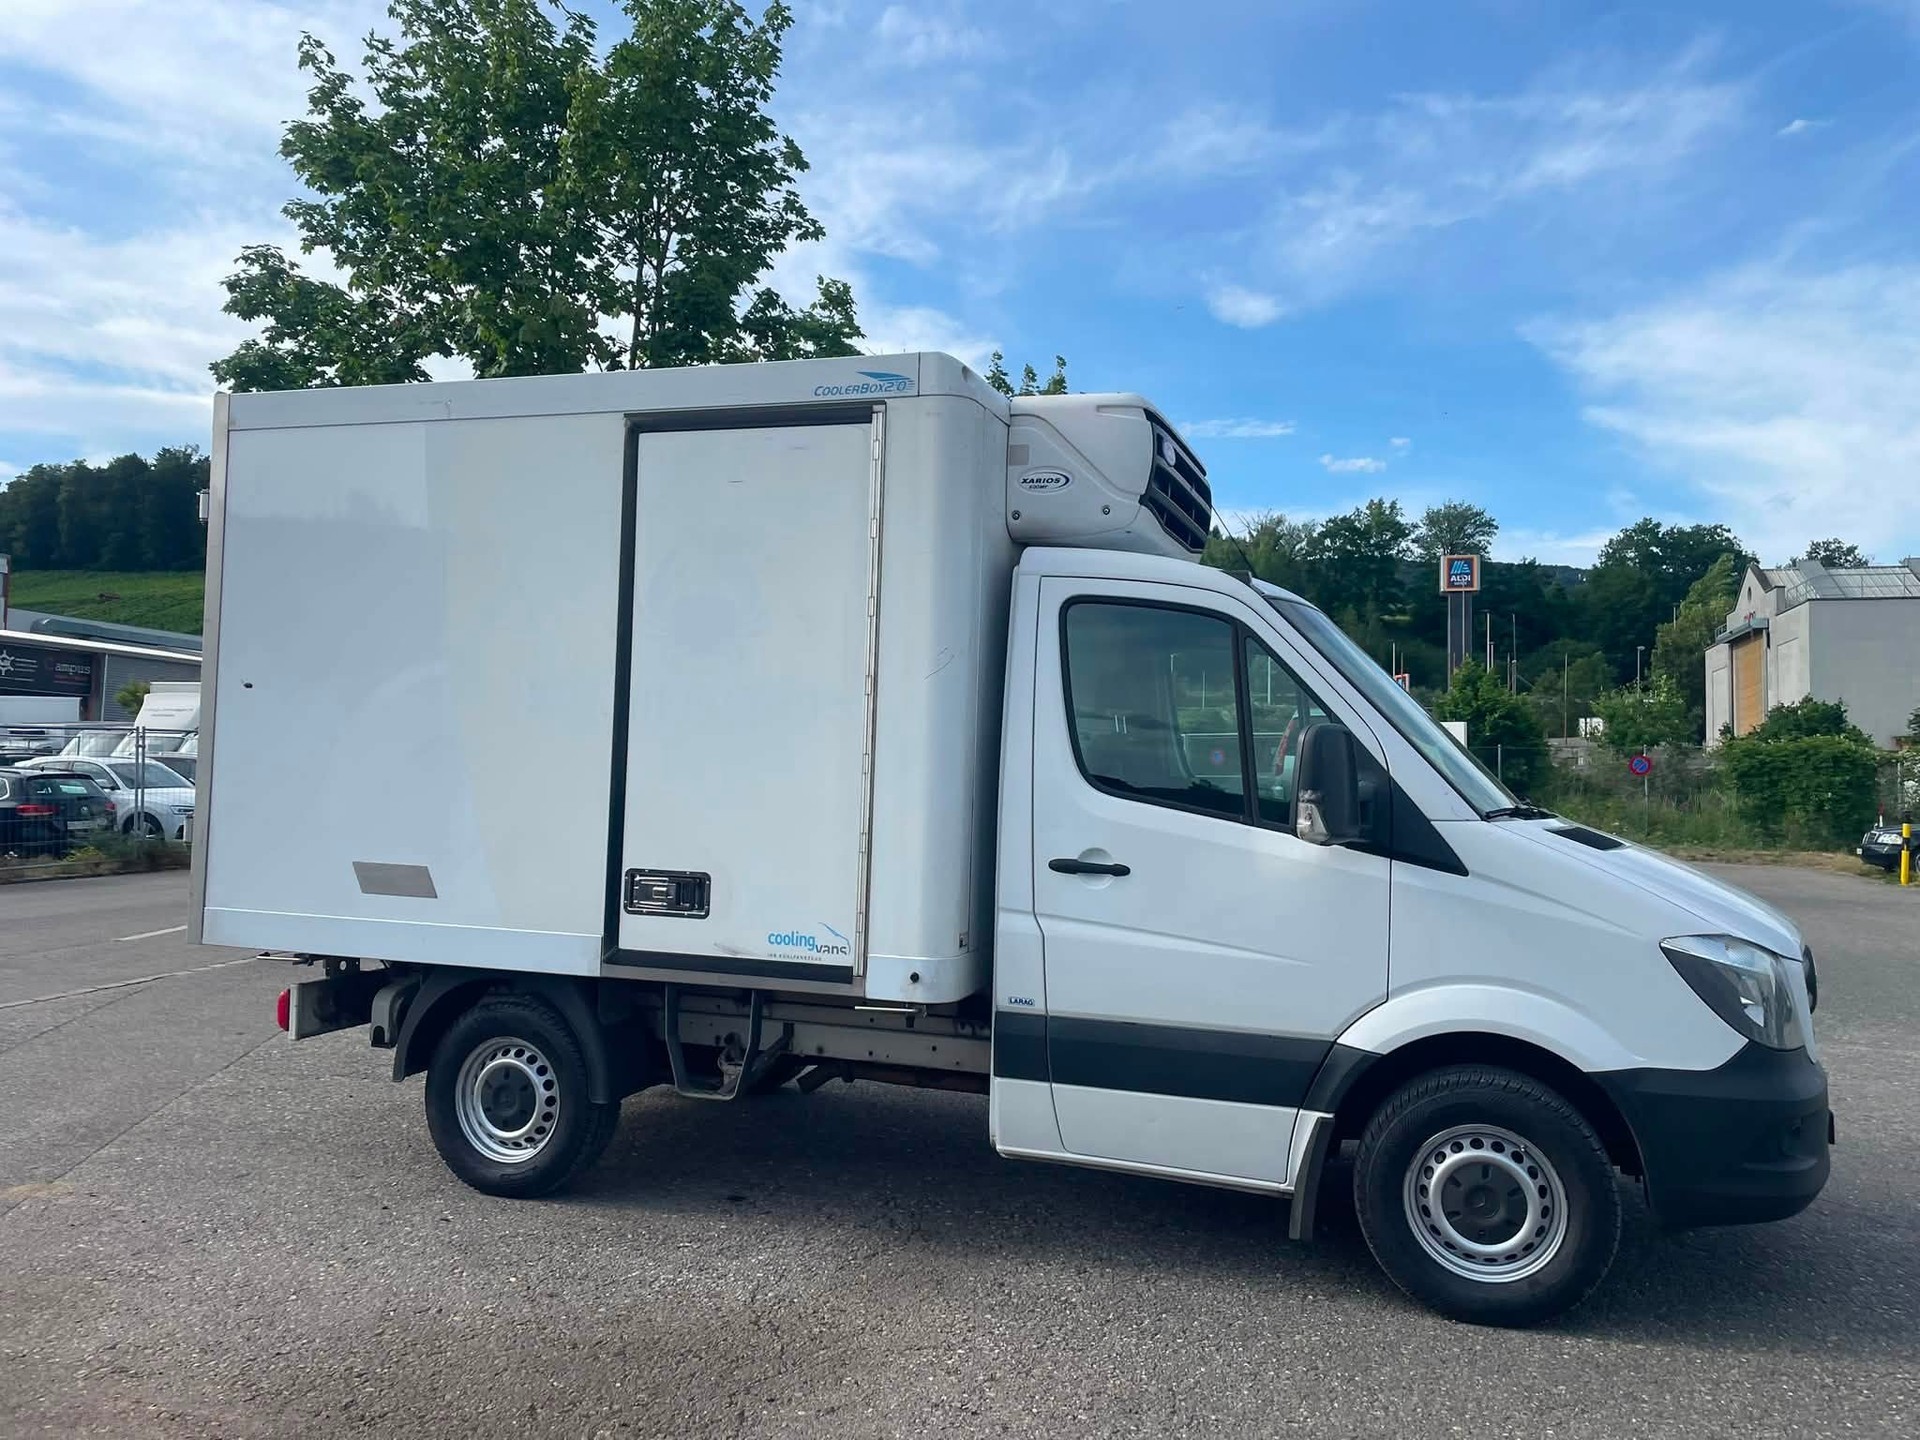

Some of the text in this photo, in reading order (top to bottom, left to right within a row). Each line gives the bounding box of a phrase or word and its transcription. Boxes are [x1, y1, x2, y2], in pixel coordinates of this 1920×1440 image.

[1450, 574, 1471, 582] ALDI
[767, 931, 815, 951] cooling
[815, 944, 847, 955] vans
